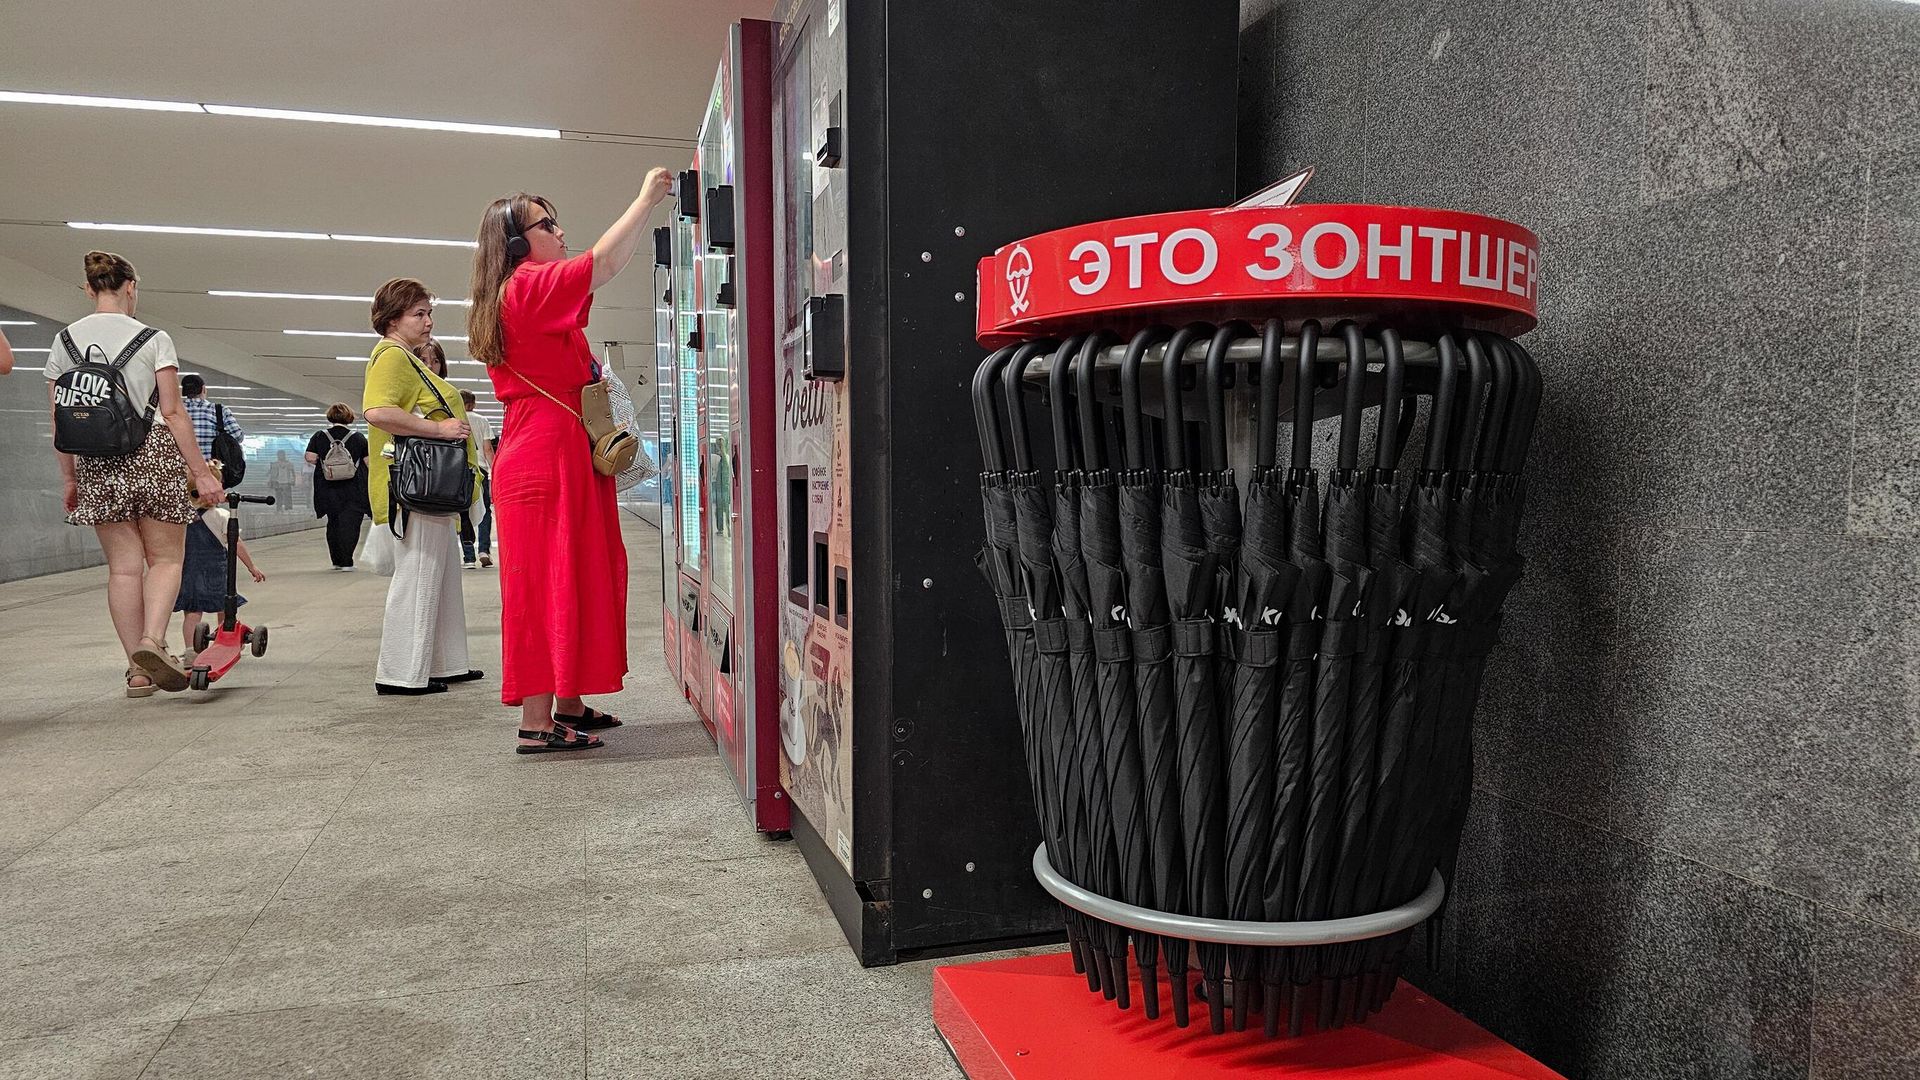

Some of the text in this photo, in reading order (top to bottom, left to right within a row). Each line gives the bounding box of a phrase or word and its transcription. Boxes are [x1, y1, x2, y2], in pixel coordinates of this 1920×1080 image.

[1068, 222, 1537, 299] ЭТО ЗОНТШЕР
[54, 385, 103, 406] GUESS
[71, 371, 111, 399] LOVE
